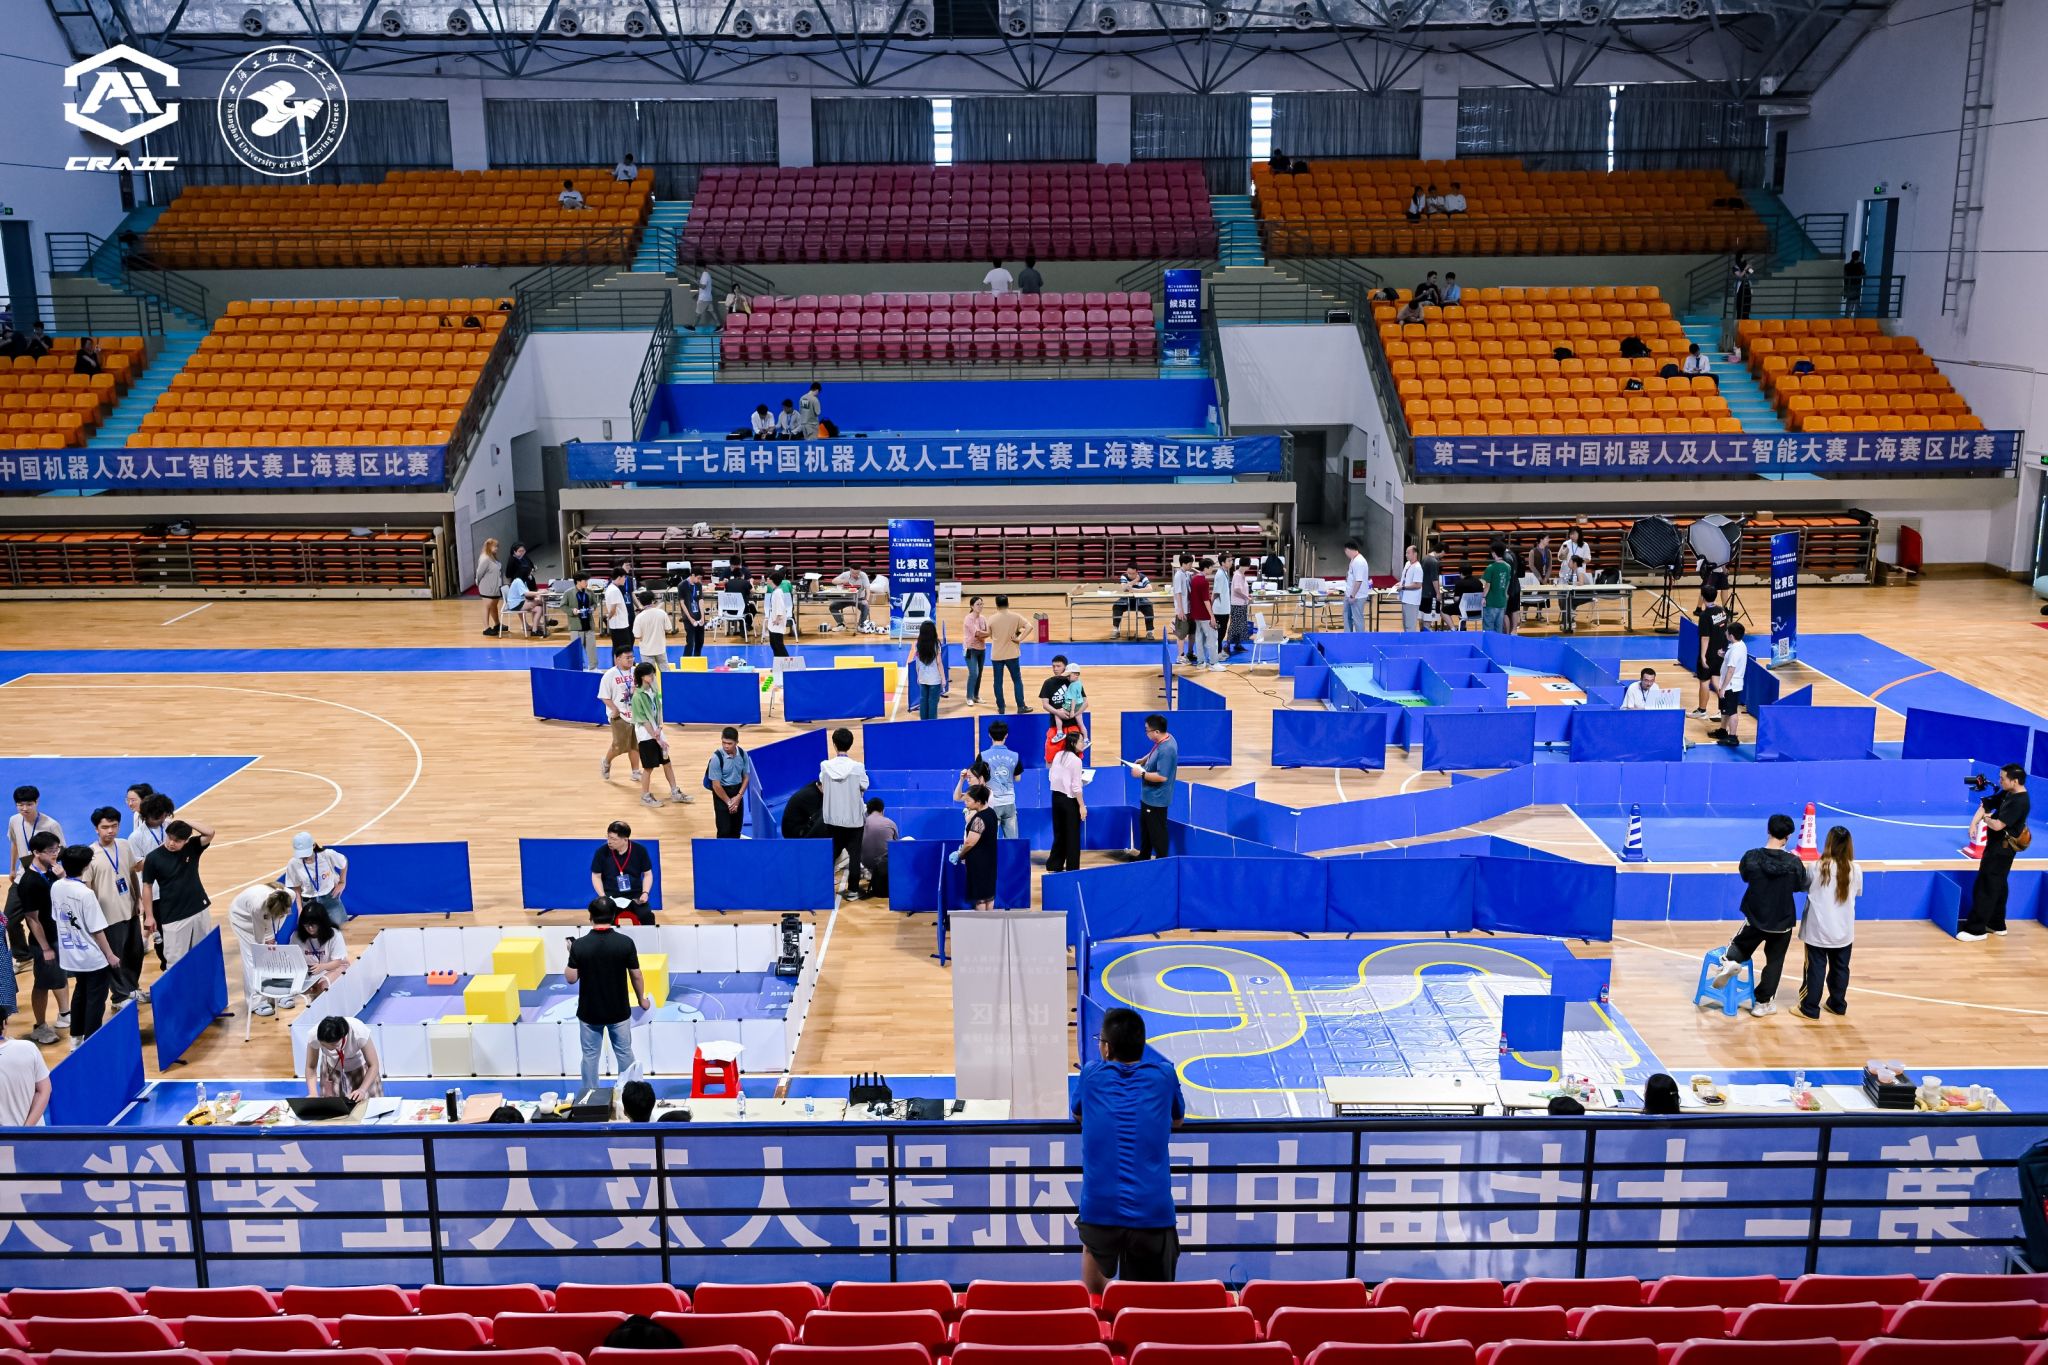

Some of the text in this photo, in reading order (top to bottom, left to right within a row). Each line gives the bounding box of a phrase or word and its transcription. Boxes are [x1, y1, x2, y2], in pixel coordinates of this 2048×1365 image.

[1169, 298, 1197, 308] 候场区
[613, 443, 1236, 475] 第二十七届中国机器人及人工智能大赛上海赛区比赛
[1433, 434, 1995, 467] 第二十七届中国机器人及人工智能大赛上海赛区比赛
[0, 451, 429, 481] 中国机器人及人工智能大赛上海赛区比赛
[896, 558, 929, 570] 比赛区
[1774, 575, 1794, 590] 比赛区
